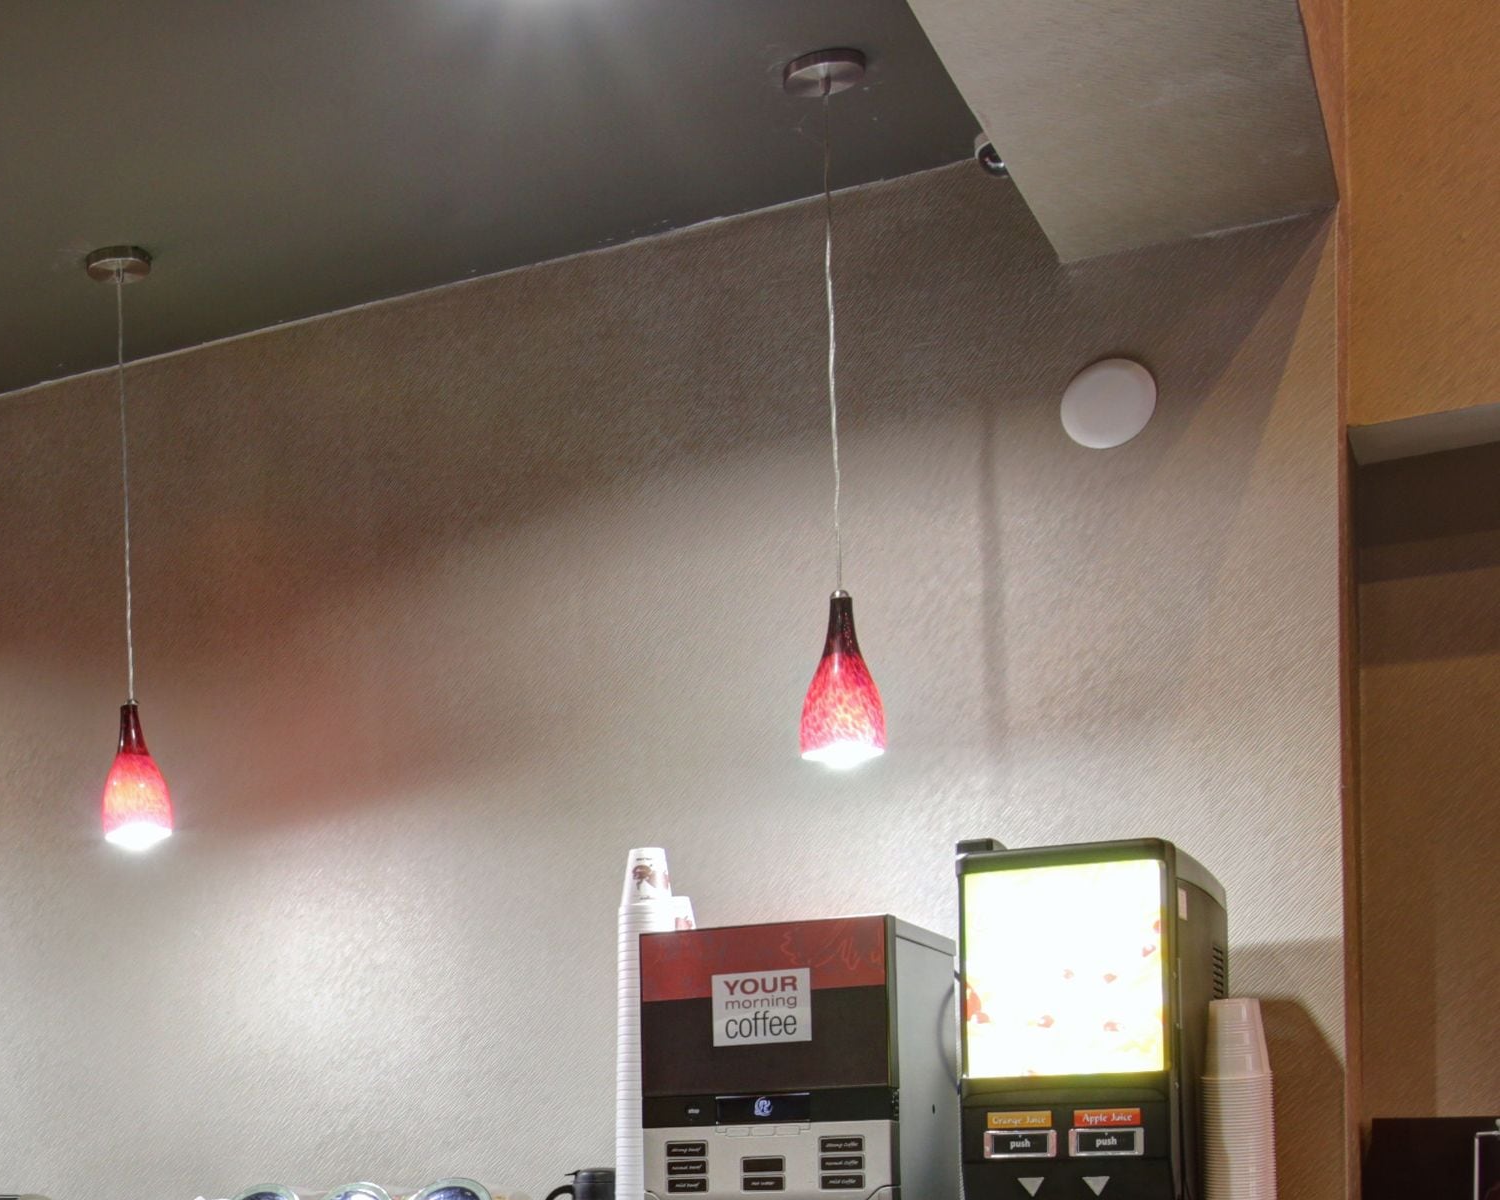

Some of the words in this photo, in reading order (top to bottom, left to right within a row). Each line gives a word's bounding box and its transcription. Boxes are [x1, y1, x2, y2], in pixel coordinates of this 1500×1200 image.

[723, 976, 798, 995] YOUR
[725, 995, 798, 1010] morning
[725, 1010, 797, 1039] coffee
[1082, 1113, 1107, 1125] Apple
[1110, 1111, 1133, 1122] Juice
[1010, 1139, 1031, 1150] push
[1095, 1136, 1117, 1147] push
